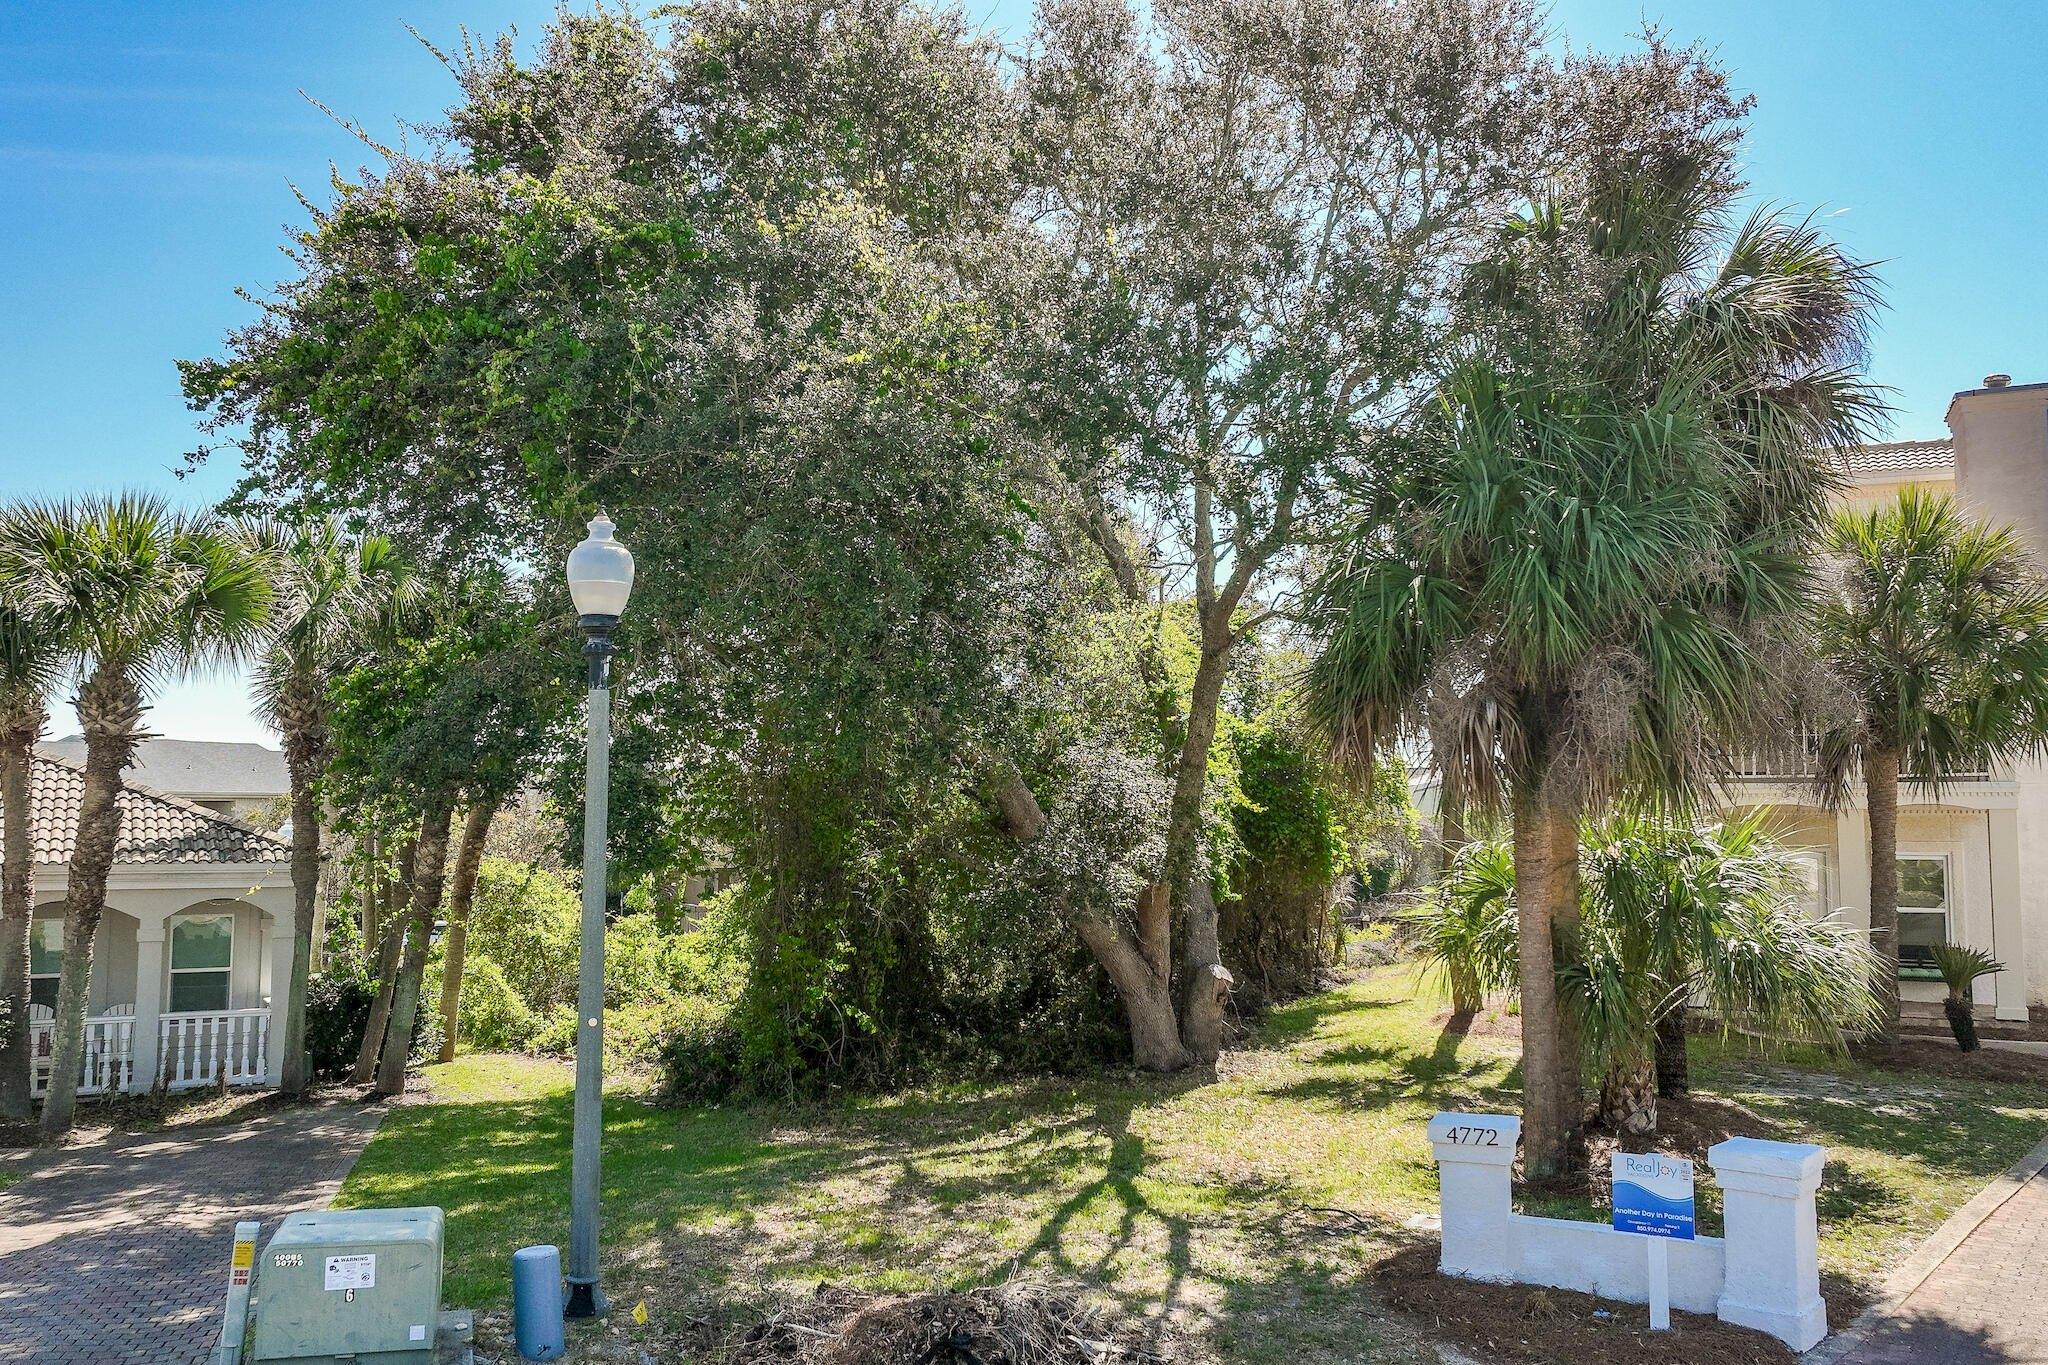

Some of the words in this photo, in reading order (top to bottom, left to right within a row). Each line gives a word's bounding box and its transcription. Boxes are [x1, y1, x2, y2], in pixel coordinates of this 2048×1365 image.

[1446, 1126, 1499, 1146] 4772
[1614, 1207, 1641, 1216] Another
[1641, 1210, 1655, 1219] Day
[1663, 1212, 1693, 1223] Paradise
[345, 1288, 355, 1303] 6
